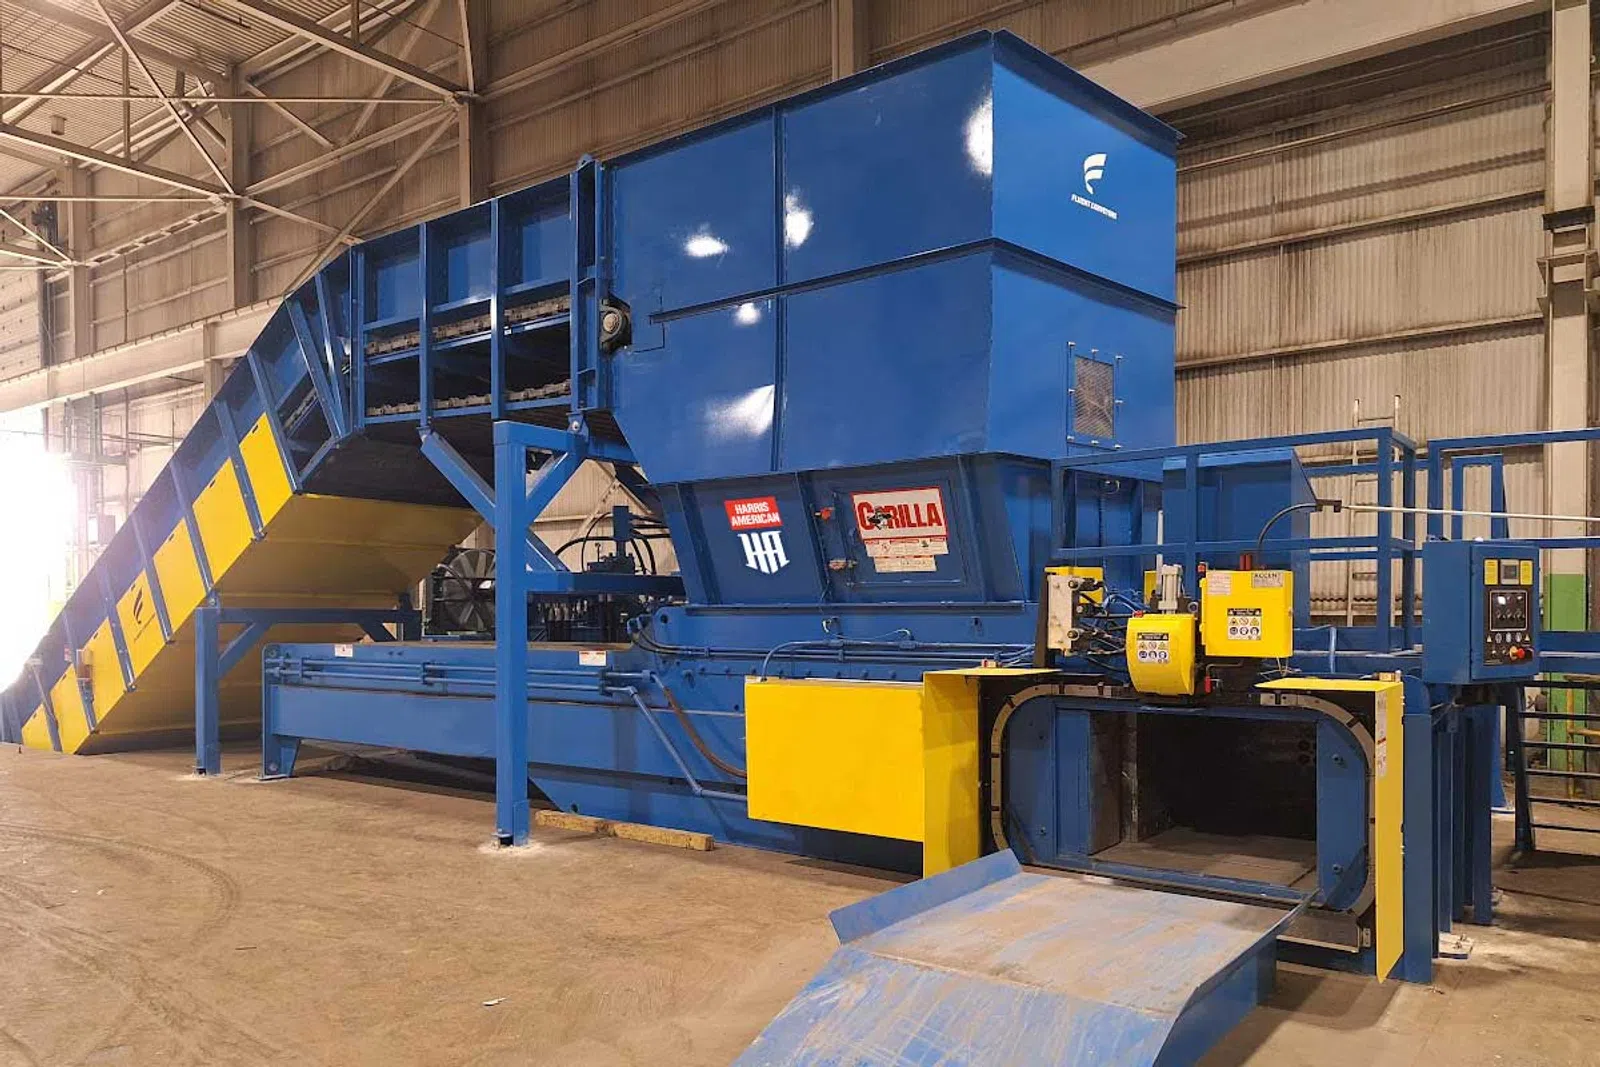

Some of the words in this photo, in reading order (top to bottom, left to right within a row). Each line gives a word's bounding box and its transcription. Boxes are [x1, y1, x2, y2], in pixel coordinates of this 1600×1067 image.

[734, 502, 769, 515] HARRIS
[857, 501, 943, 530] GRILLA
[731, 512, 780, 527] AMERICAN
